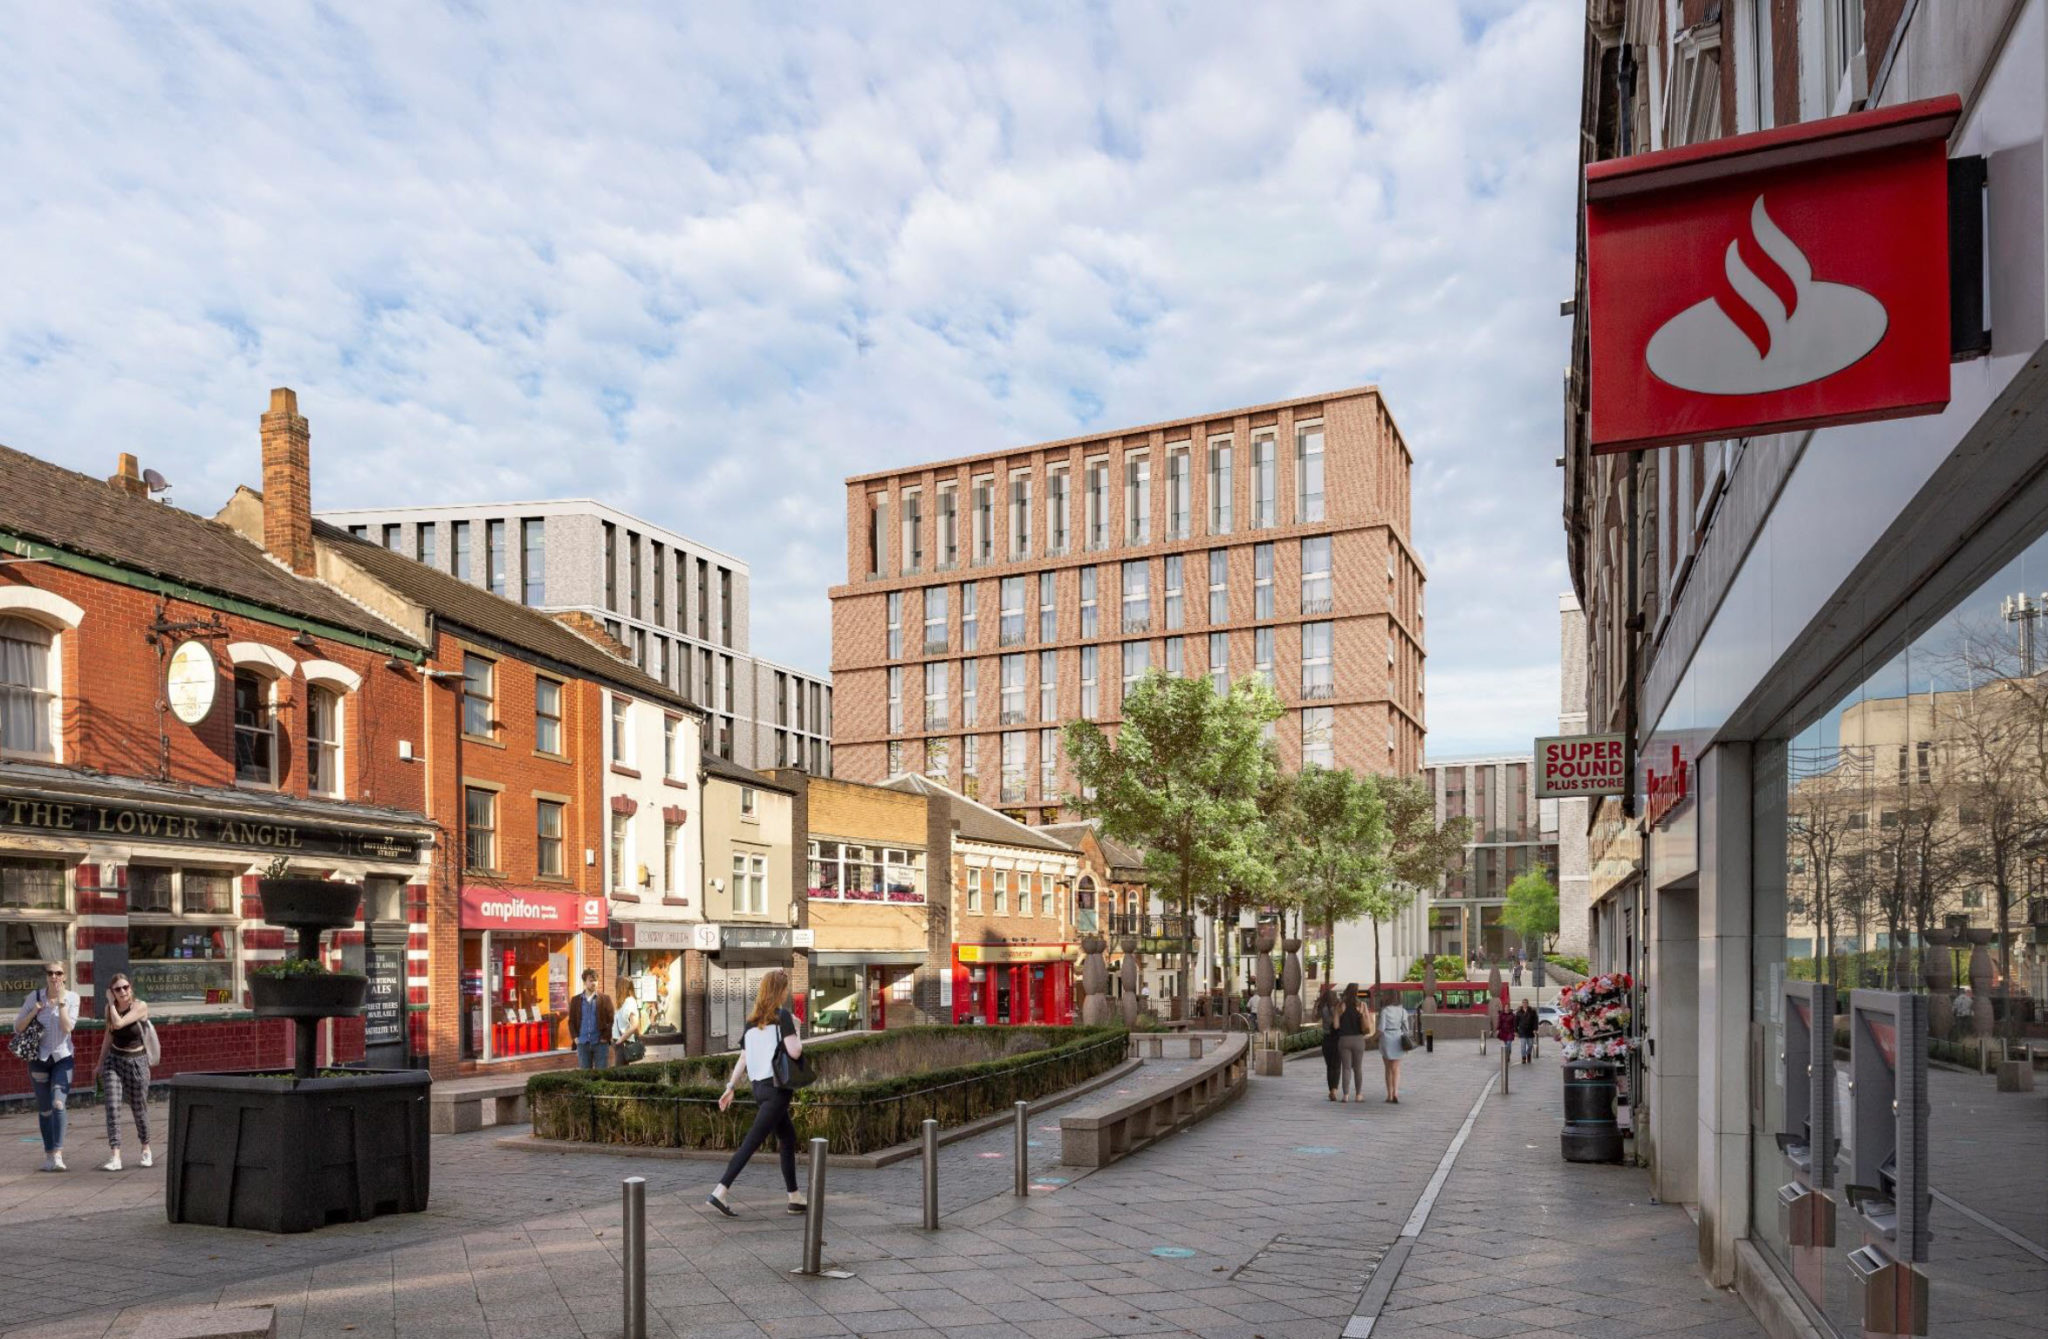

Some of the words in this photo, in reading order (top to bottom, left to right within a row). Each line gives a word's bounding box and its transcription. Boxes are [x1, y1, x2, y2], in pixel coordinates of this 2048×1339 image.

[1546, 741, 1624, 762] SUPER
[1546, 760, 1625, 778] POUND
[1547, 780, 1579, 791] PLUS
[1581, 777, 1625, 789] STORE
[8, 800, 74, 829] THE
[99, 809, 200, 839] LOWER
[220, 822, 303, 848] ANGEL
[384, 836, 394, 844] 27
[377, 850, 399, 858] STREET
[481, 898, 540, 922] amplifon
[136, 974, 189, 983] WALKER'S
[146, 983, 196, 992] WARRINGTON
[371, 984, 392, 994] ALES
